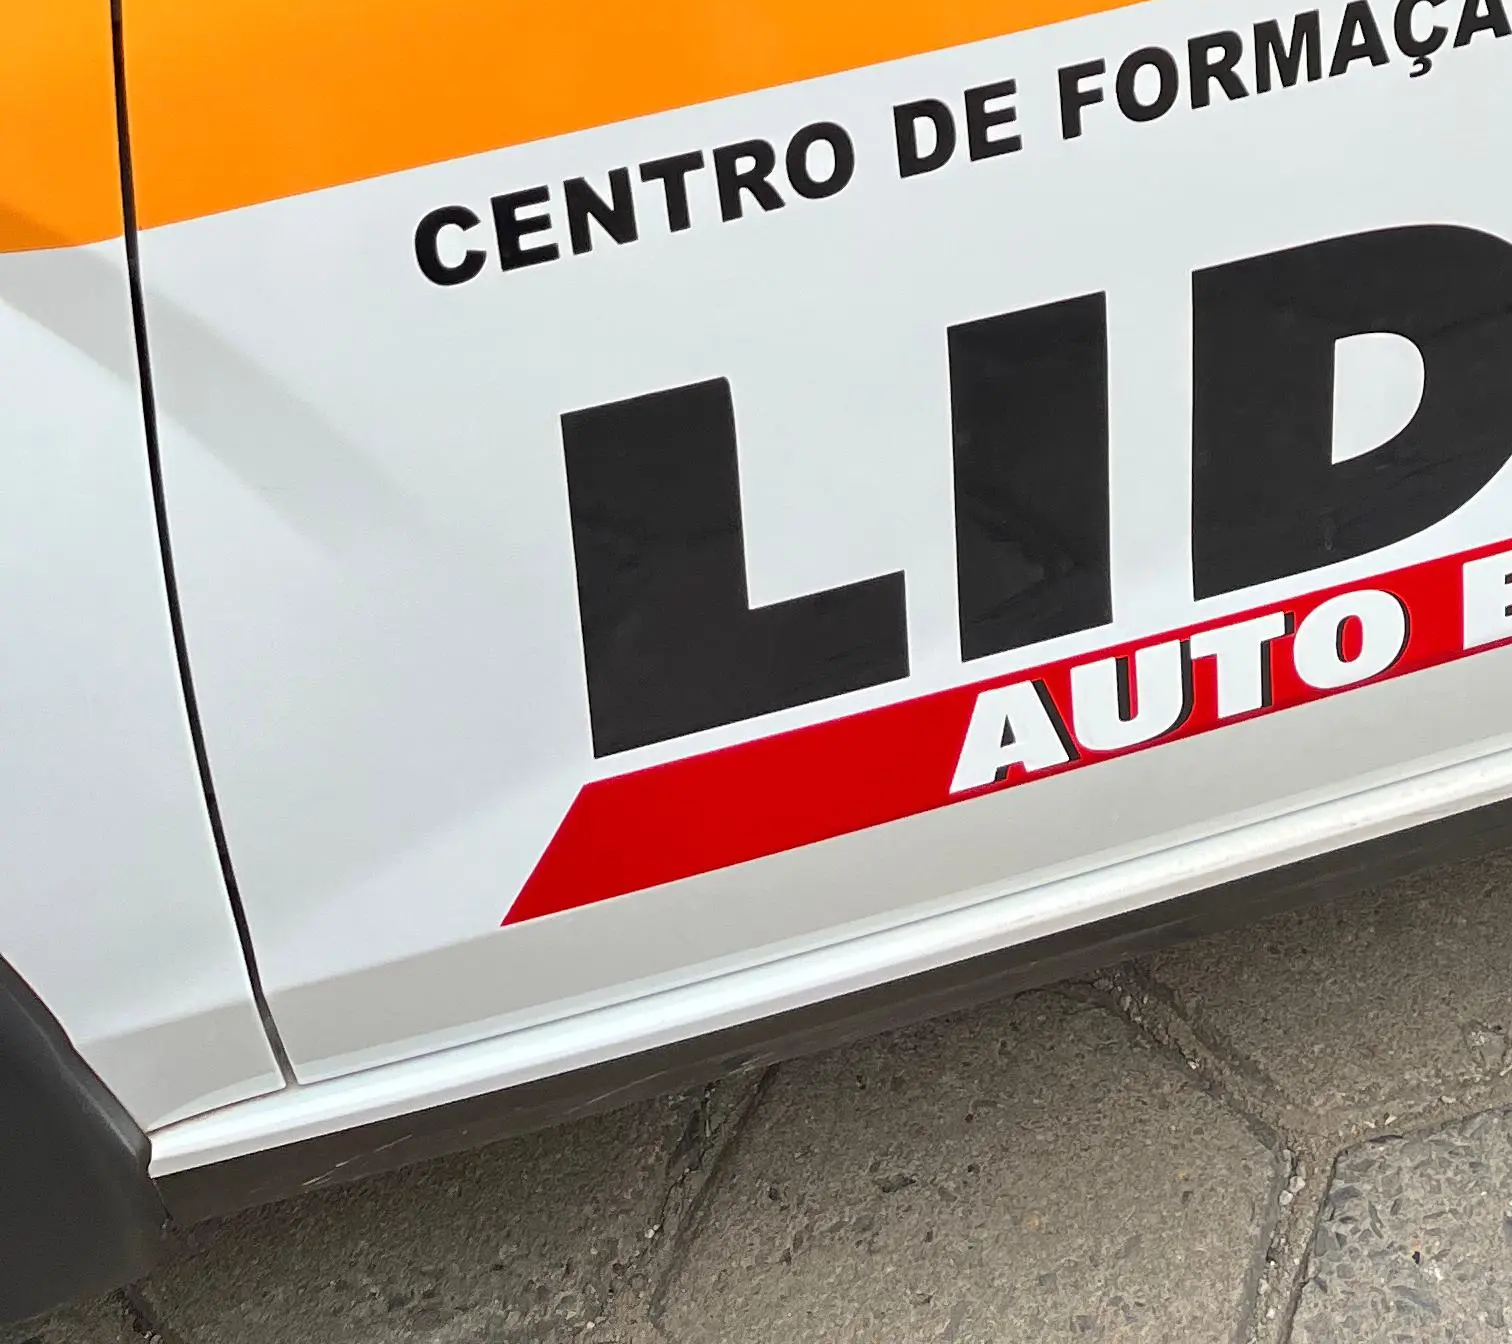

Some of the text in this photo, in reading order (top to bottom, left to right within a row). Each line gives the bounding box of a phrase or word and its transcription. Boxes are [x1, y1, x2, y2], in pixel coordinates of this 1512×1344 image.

[414, 120, 855, 286] CENTRO
[893, 78, 1022, 178] DE
[948, 589, 1416, 796] AUTO
